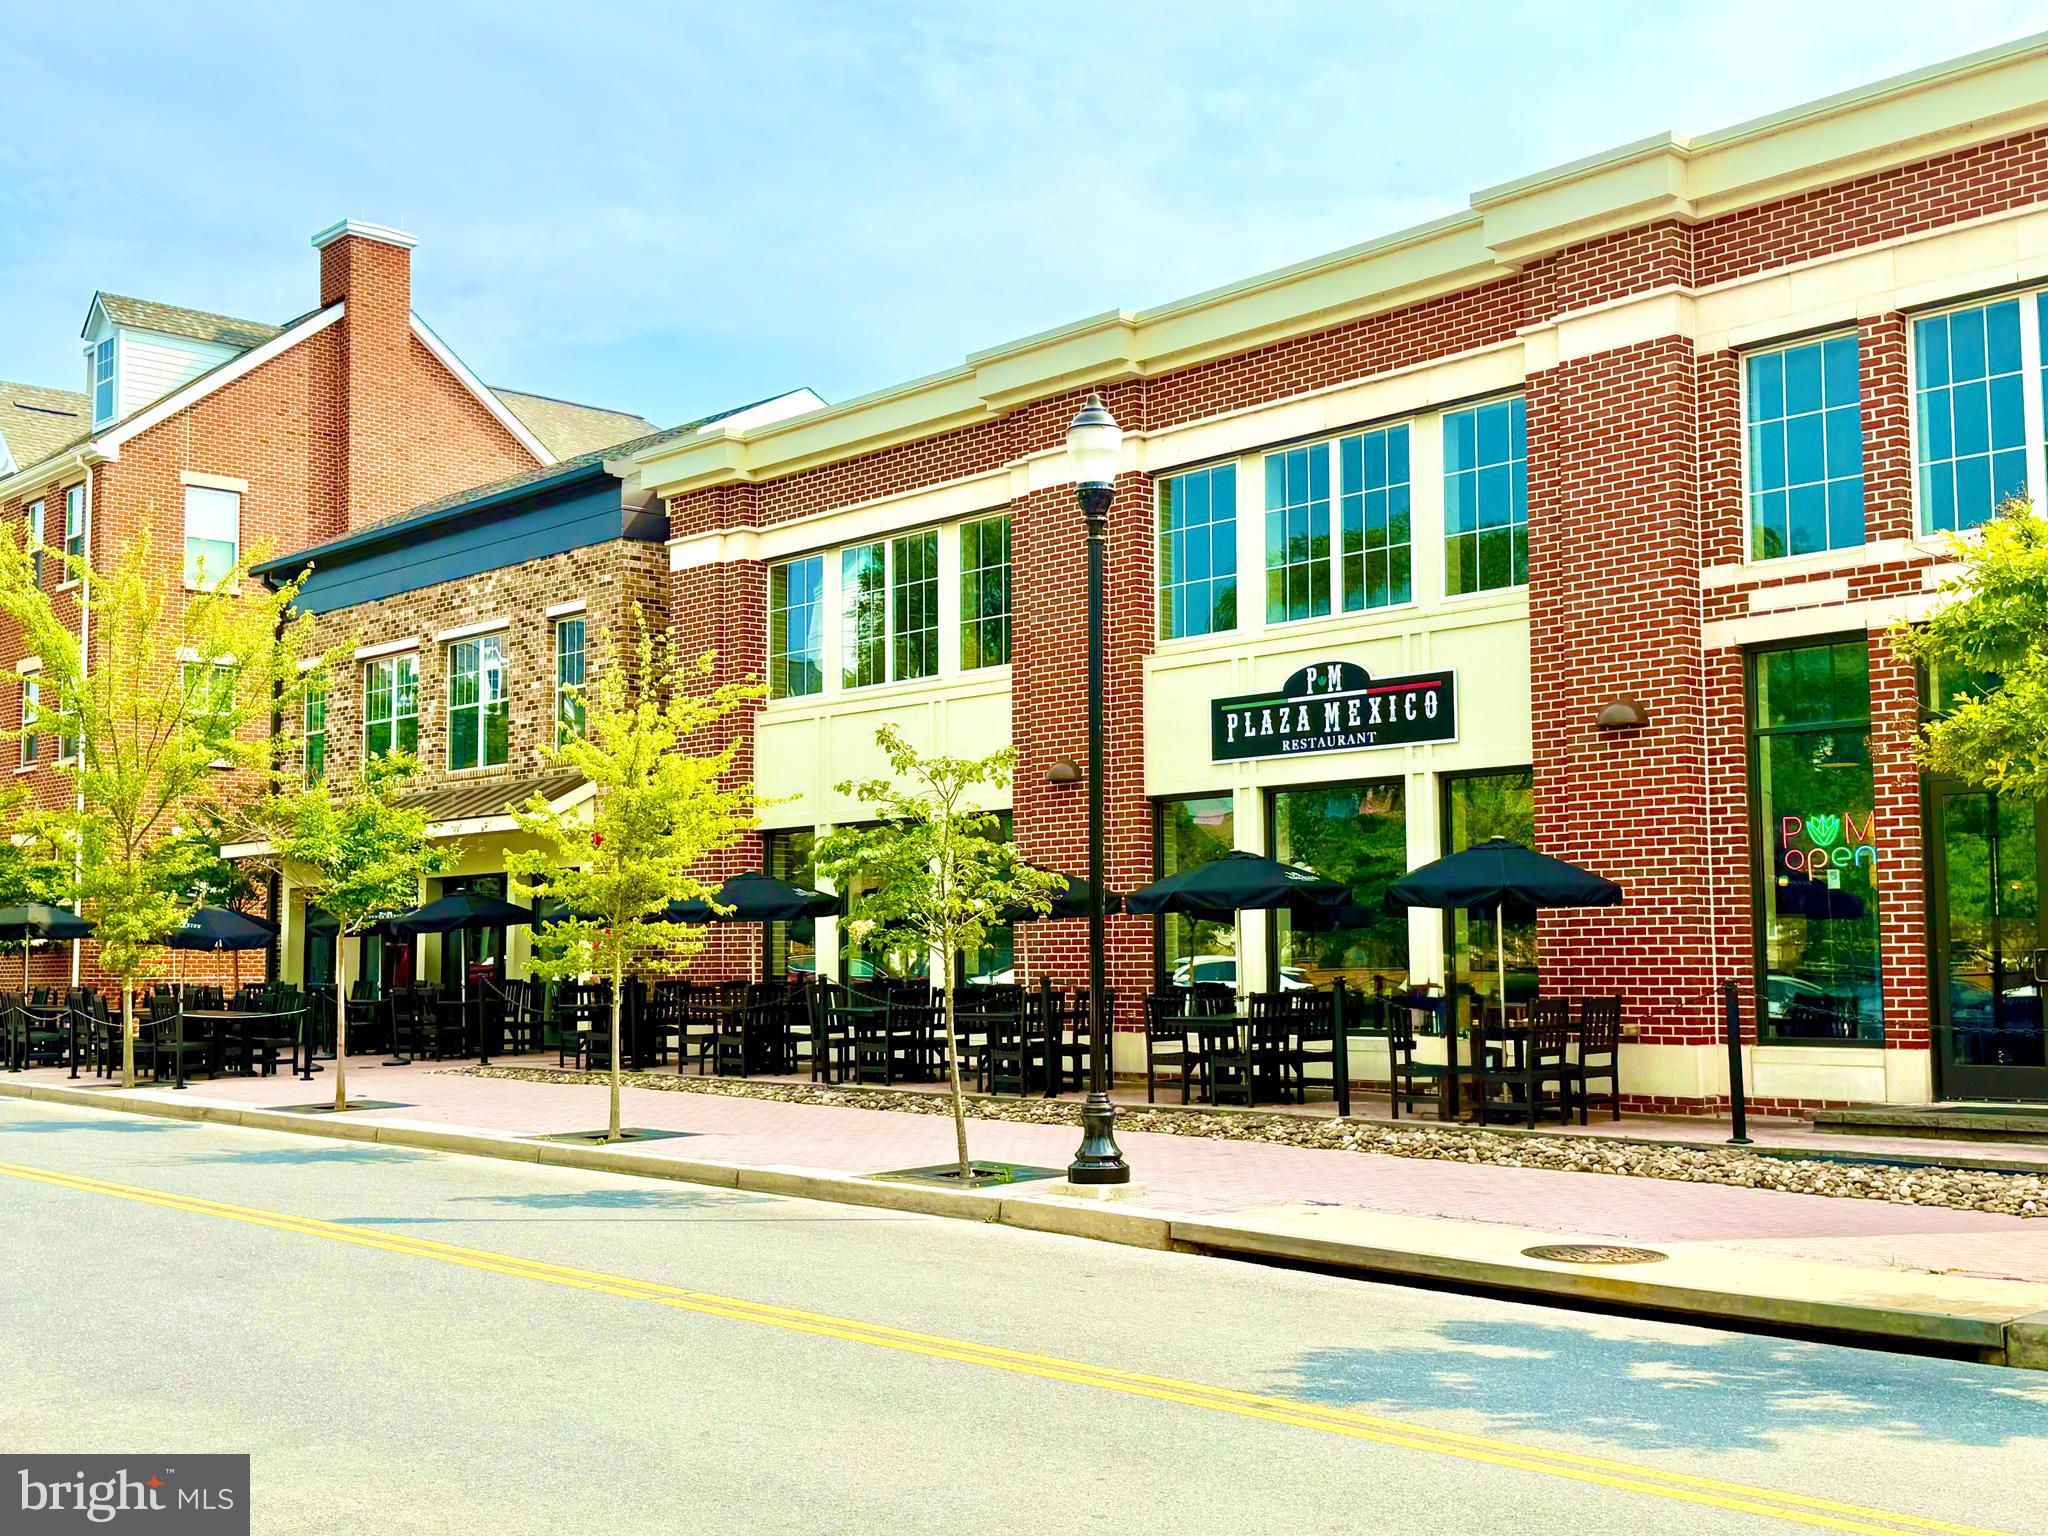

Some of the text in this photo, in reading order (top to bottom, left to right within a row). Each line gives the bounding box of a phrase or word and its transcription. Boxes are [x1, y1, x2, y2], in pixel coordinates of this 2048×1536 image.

[1226, 690, 1438, 743] PLAZA MEXICO
[1282, 731, 1377, 752] RESTAURANT
[1784, 845, 1878, 882] open
